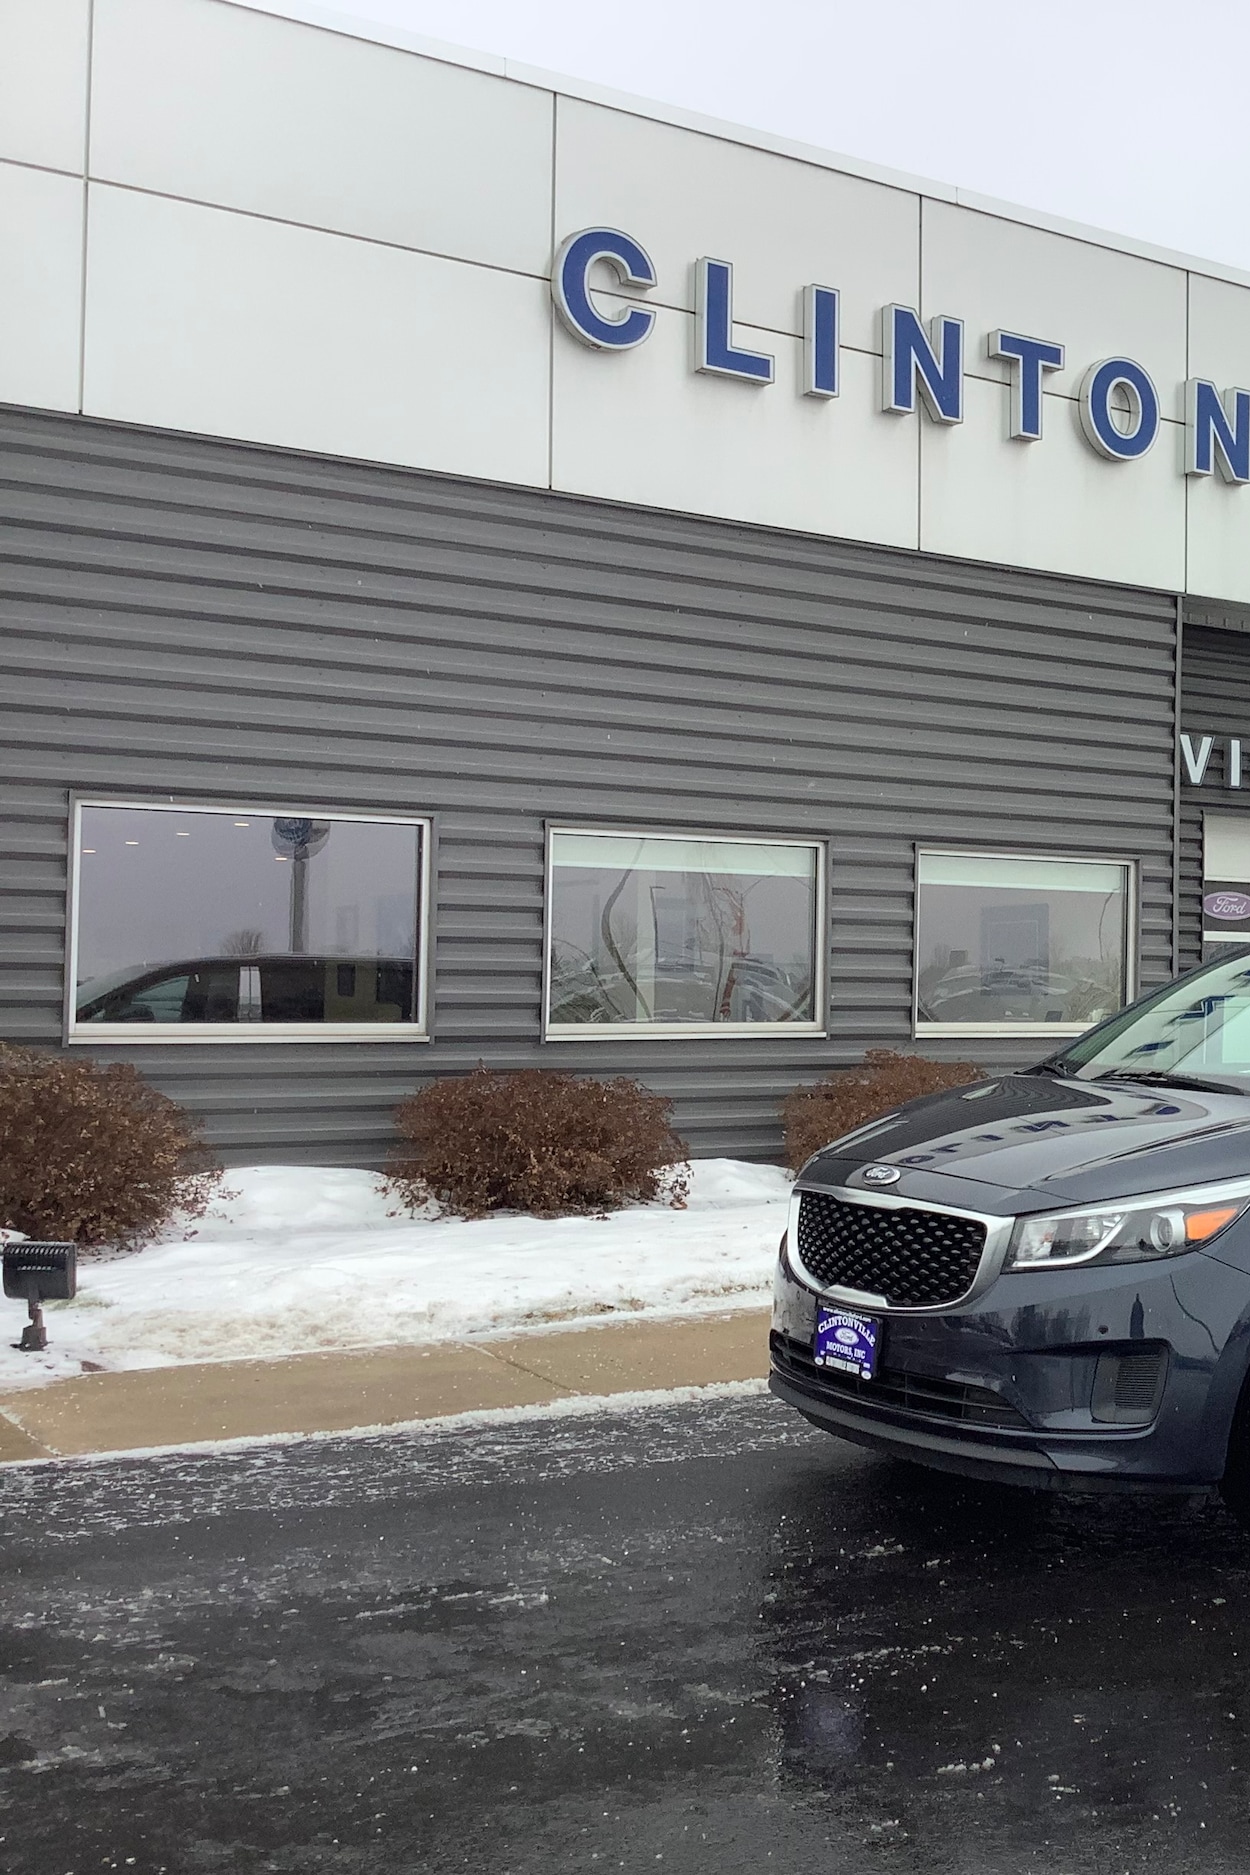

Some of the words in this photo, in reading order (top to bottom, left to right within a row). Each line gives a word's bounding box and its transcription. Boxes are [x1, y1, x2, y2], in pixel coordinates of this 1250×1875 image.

[1212, 895, 1247, 915] Ford
[818, 1315, 876, 1347] CLINTONVILLE
[854, 1348, 866, 1359] INC
